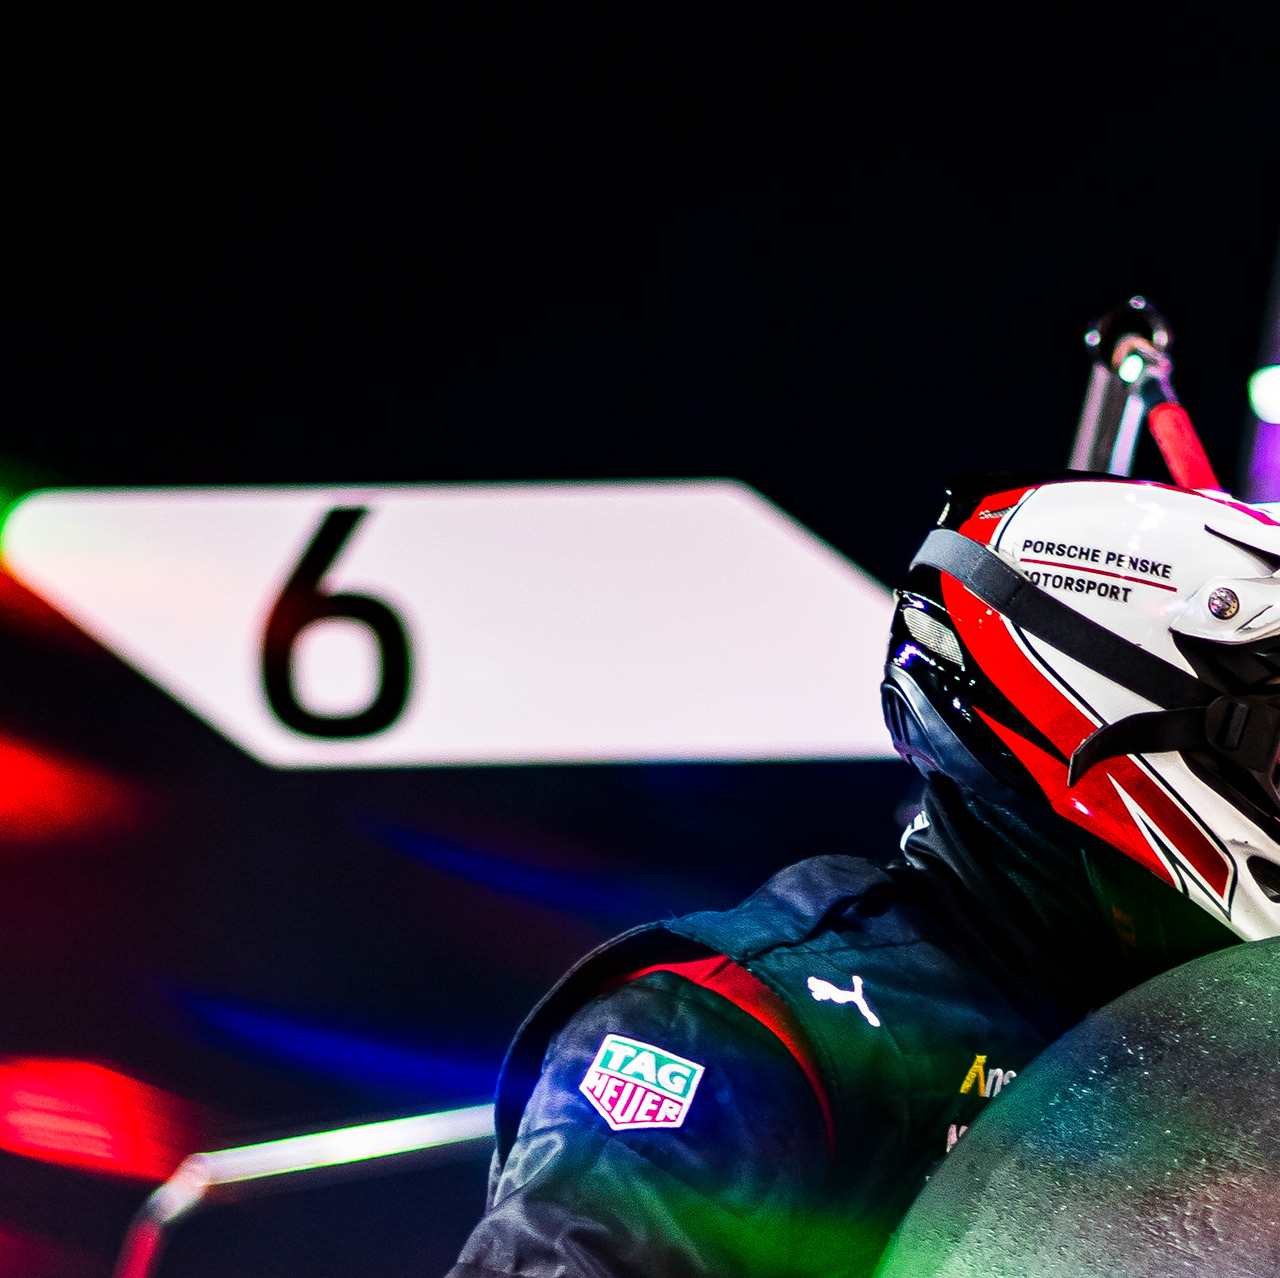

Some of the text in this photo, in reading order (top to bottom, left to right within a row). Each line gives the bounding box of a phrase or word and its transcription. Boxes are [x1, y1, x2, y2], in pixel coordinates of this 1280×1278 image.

[1022, 539, 1172, 579] PORSCHE PENSKE
[1023, 571, 1132, 603] OTORSPORT
[260, 504, 414, 741] 6
[606, 1042, 692, 1095] TAG
[587, 1072, 682, 1123] HEUER
